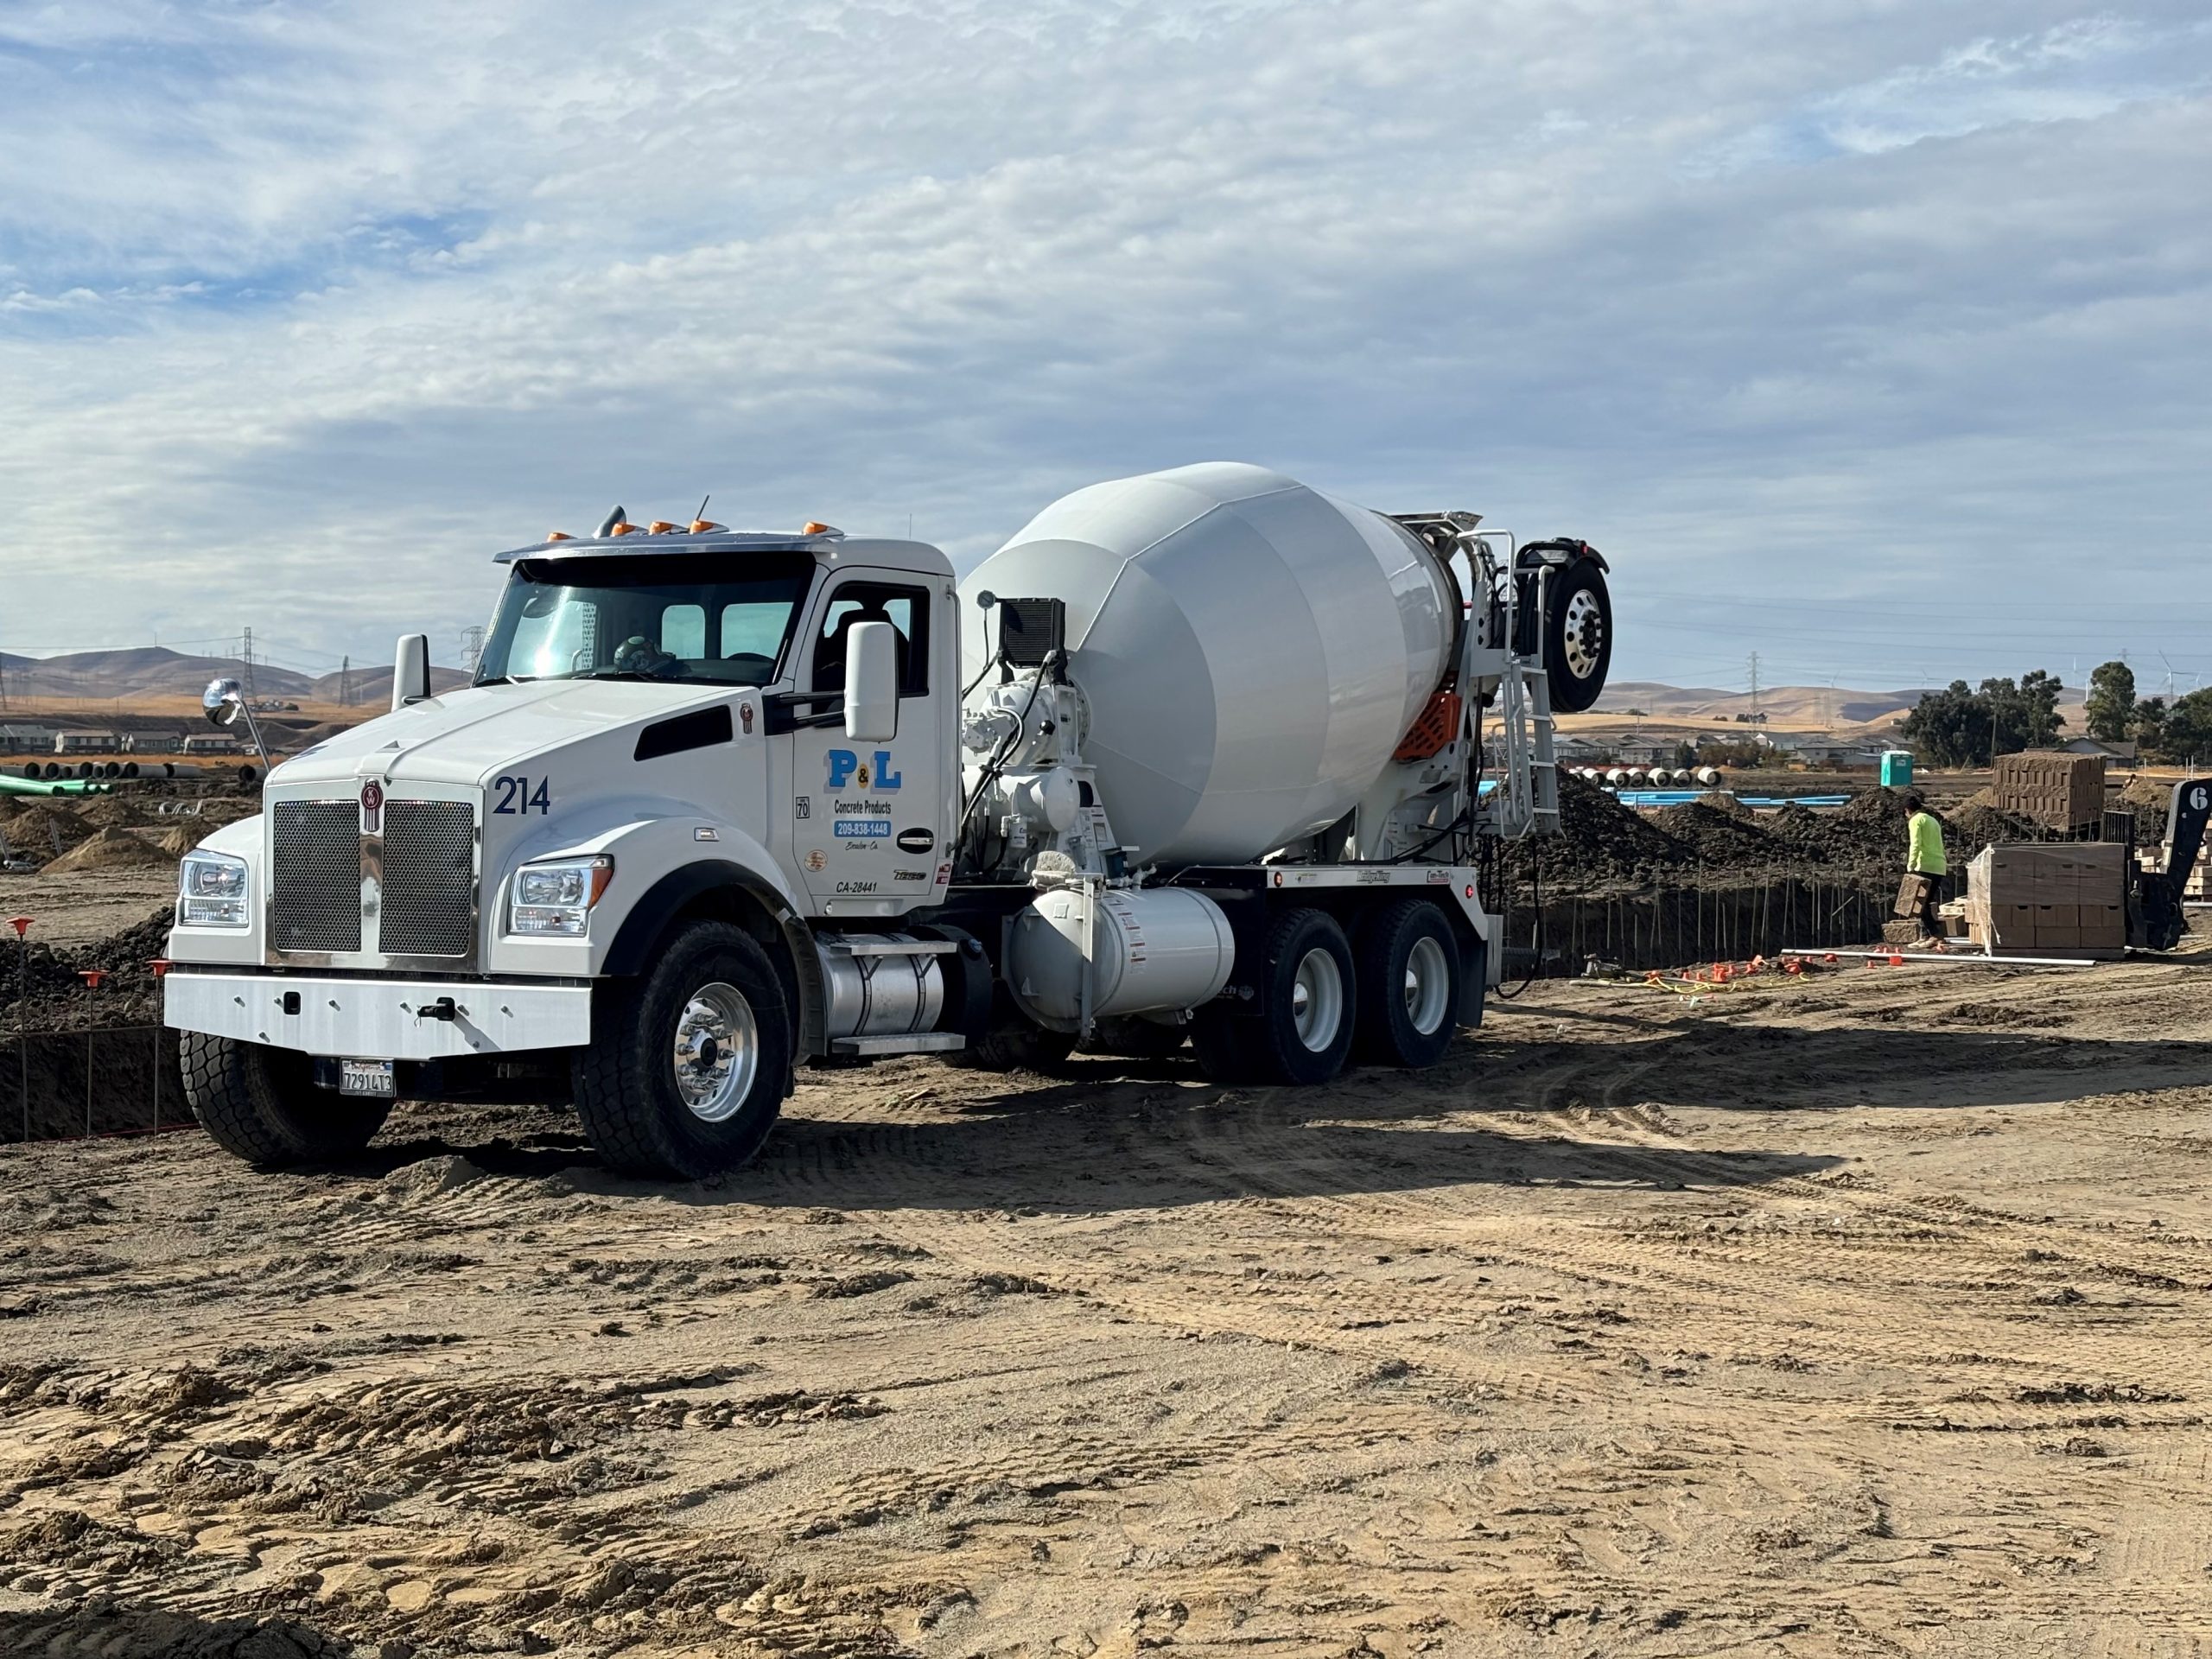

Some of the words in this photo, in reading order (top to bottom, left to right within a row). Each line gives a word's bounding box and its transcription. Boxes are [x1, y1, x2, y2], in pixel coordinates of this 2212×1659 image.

[493, 775, 550, 815] 214
[2190, 786, 2209, 810] 6
[797, 803, 808, 817] 70
[835, 799, 863, 815] Concrete
[865, 800, 892, 815] Products
[837, 823, 888, 836] 209-838-1448
[836, 881, 877, 893] CA-28441
[343, 1072, 392, 1091] 72914T3
